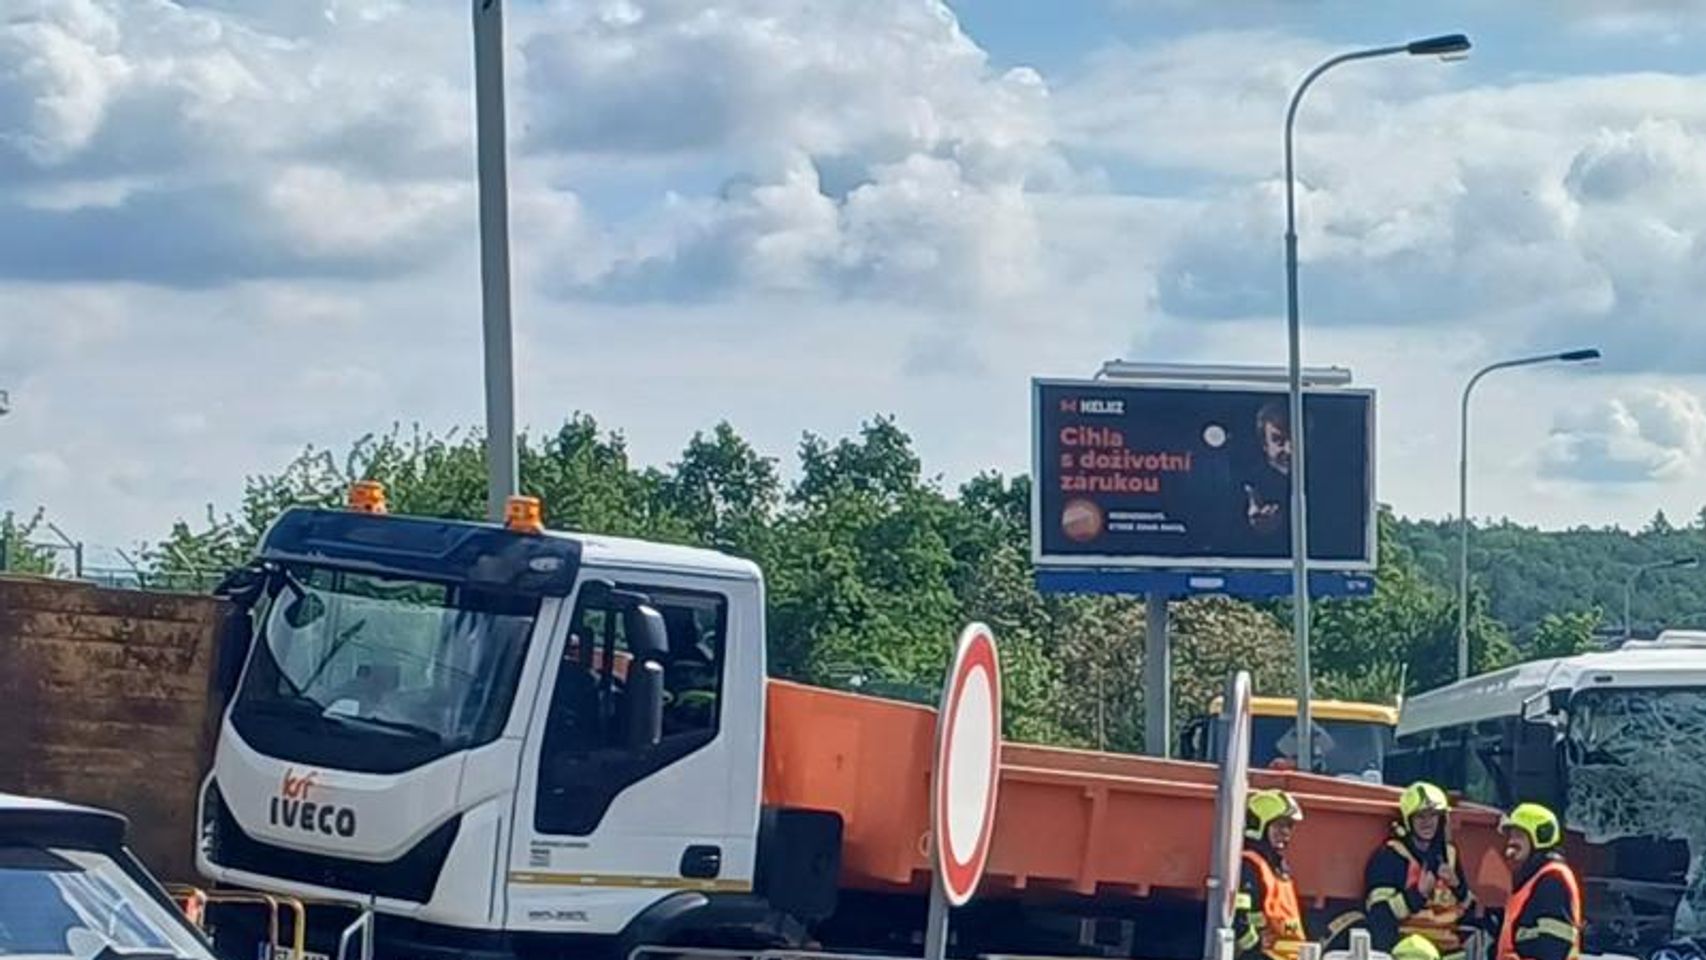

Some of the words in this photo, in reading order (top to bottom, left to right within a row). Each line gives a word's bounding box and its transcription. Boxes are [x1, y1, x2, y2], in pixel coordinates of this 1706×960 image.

[1060, 426, 1123, 446] Cihla
[1080, 449, 1191, 471] doživotní
[1061, 470, 1159, 492] zárukou
[270, 796, 356, 837] IVECO
